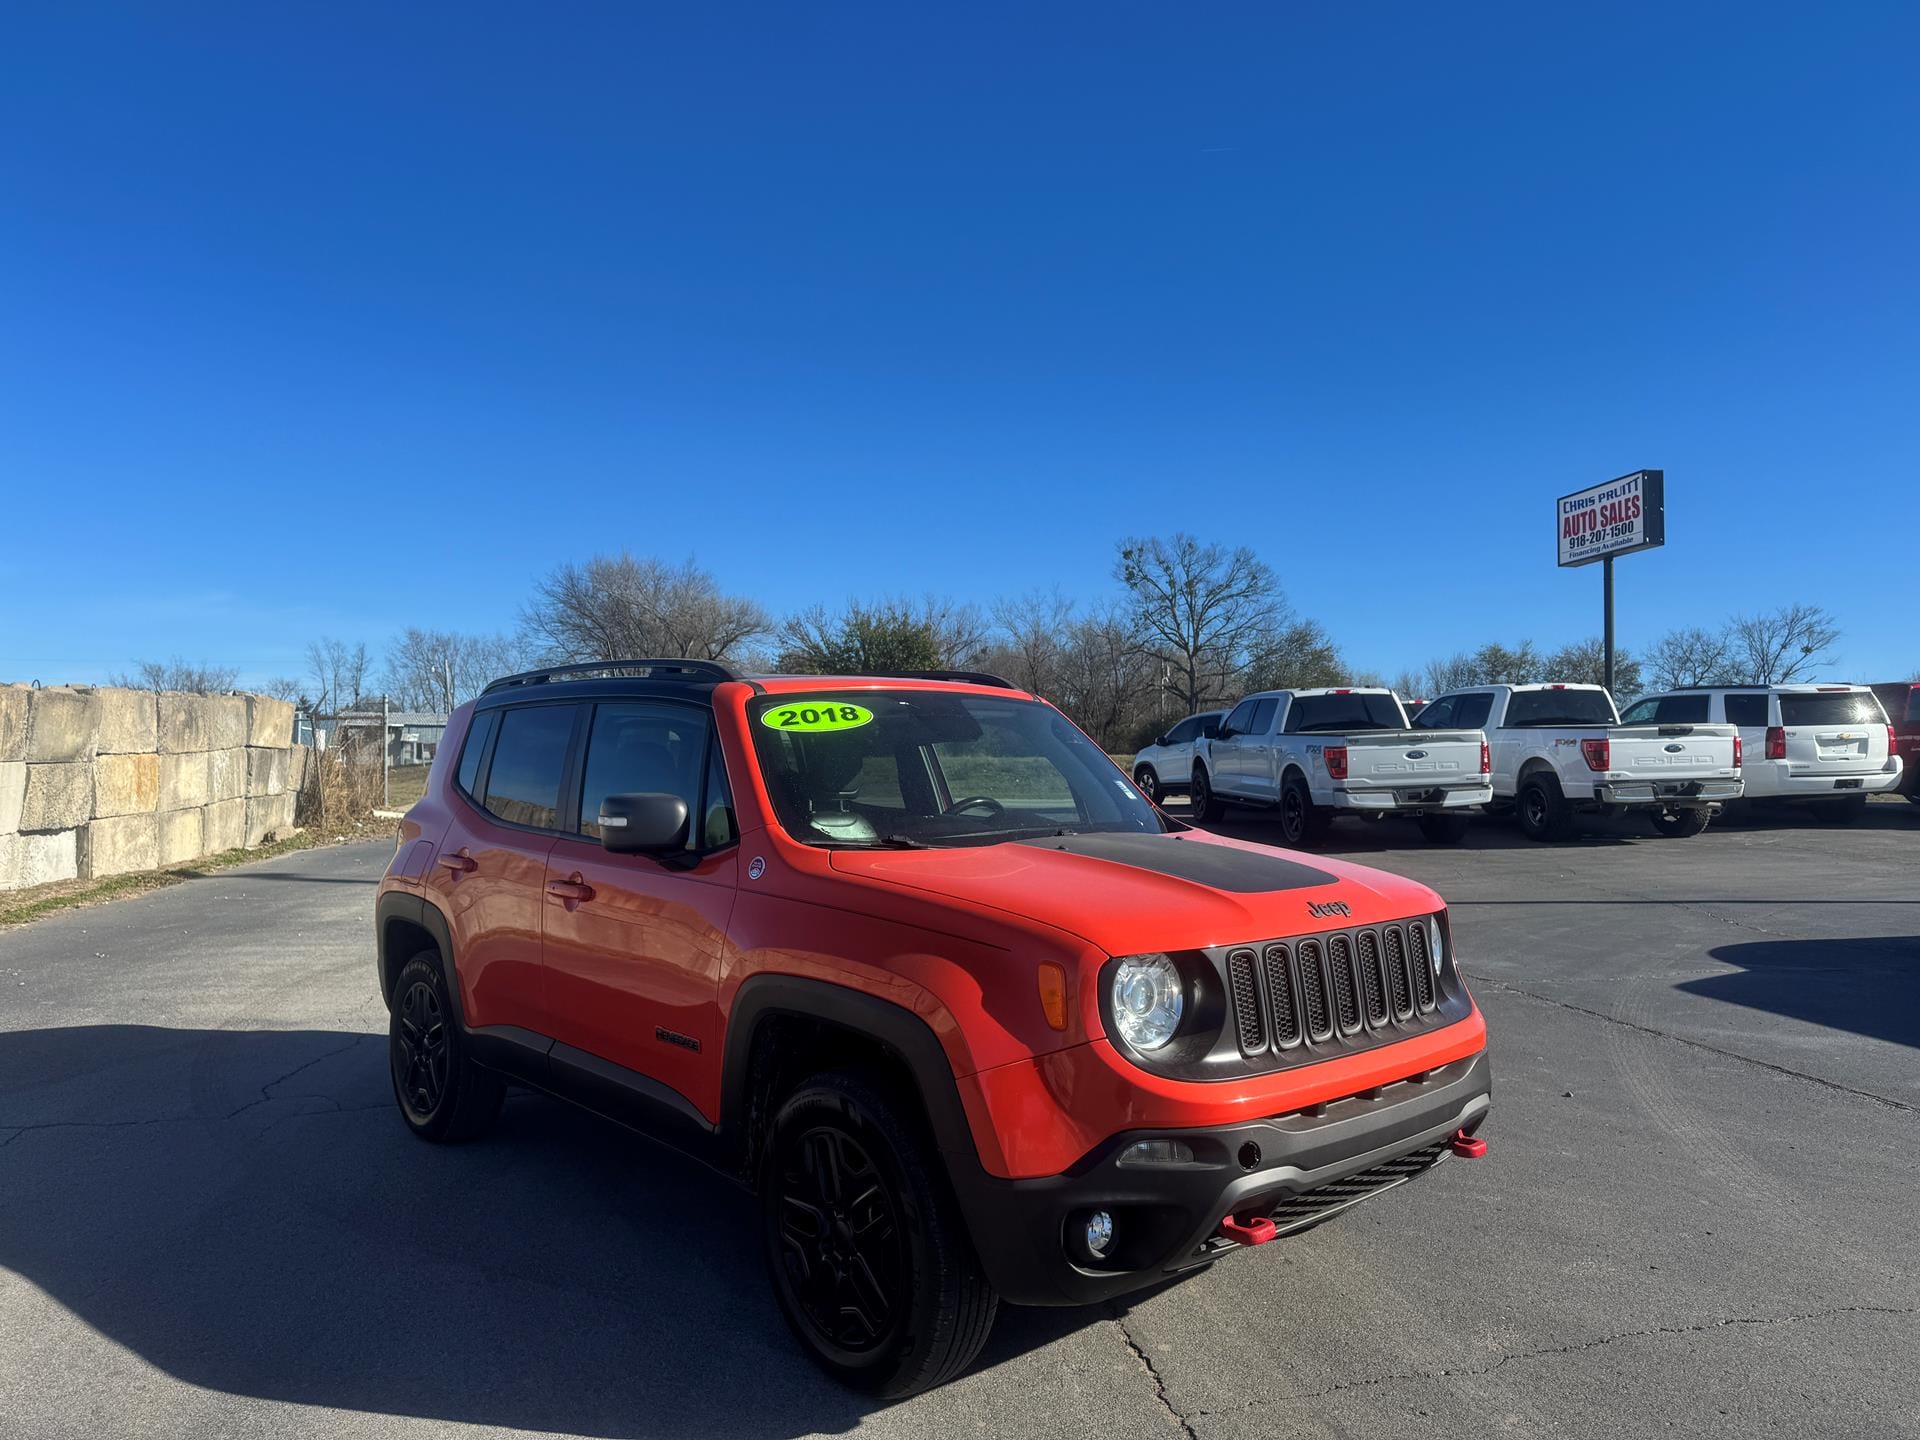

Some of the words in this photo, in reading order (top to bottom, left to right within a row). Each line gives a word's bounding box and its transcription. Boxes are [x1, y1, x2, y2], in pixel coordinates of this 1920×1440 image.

[1563, 496, 1595, 514] CHRIS
[1598, 477, 1640, 503] PRUITT
[1563, 508, 1597, 539] AUTO
[1600, 494, 1640, 528] SALES
[1569, 521, 1634, 549] 918-207-1500
[1569, 545, 1601, 559] Financing
[1602, 536, 1634, 550] Available
[778, 707, 859, 726] 2018
[1307, 901, 1351, 918] Jeep
